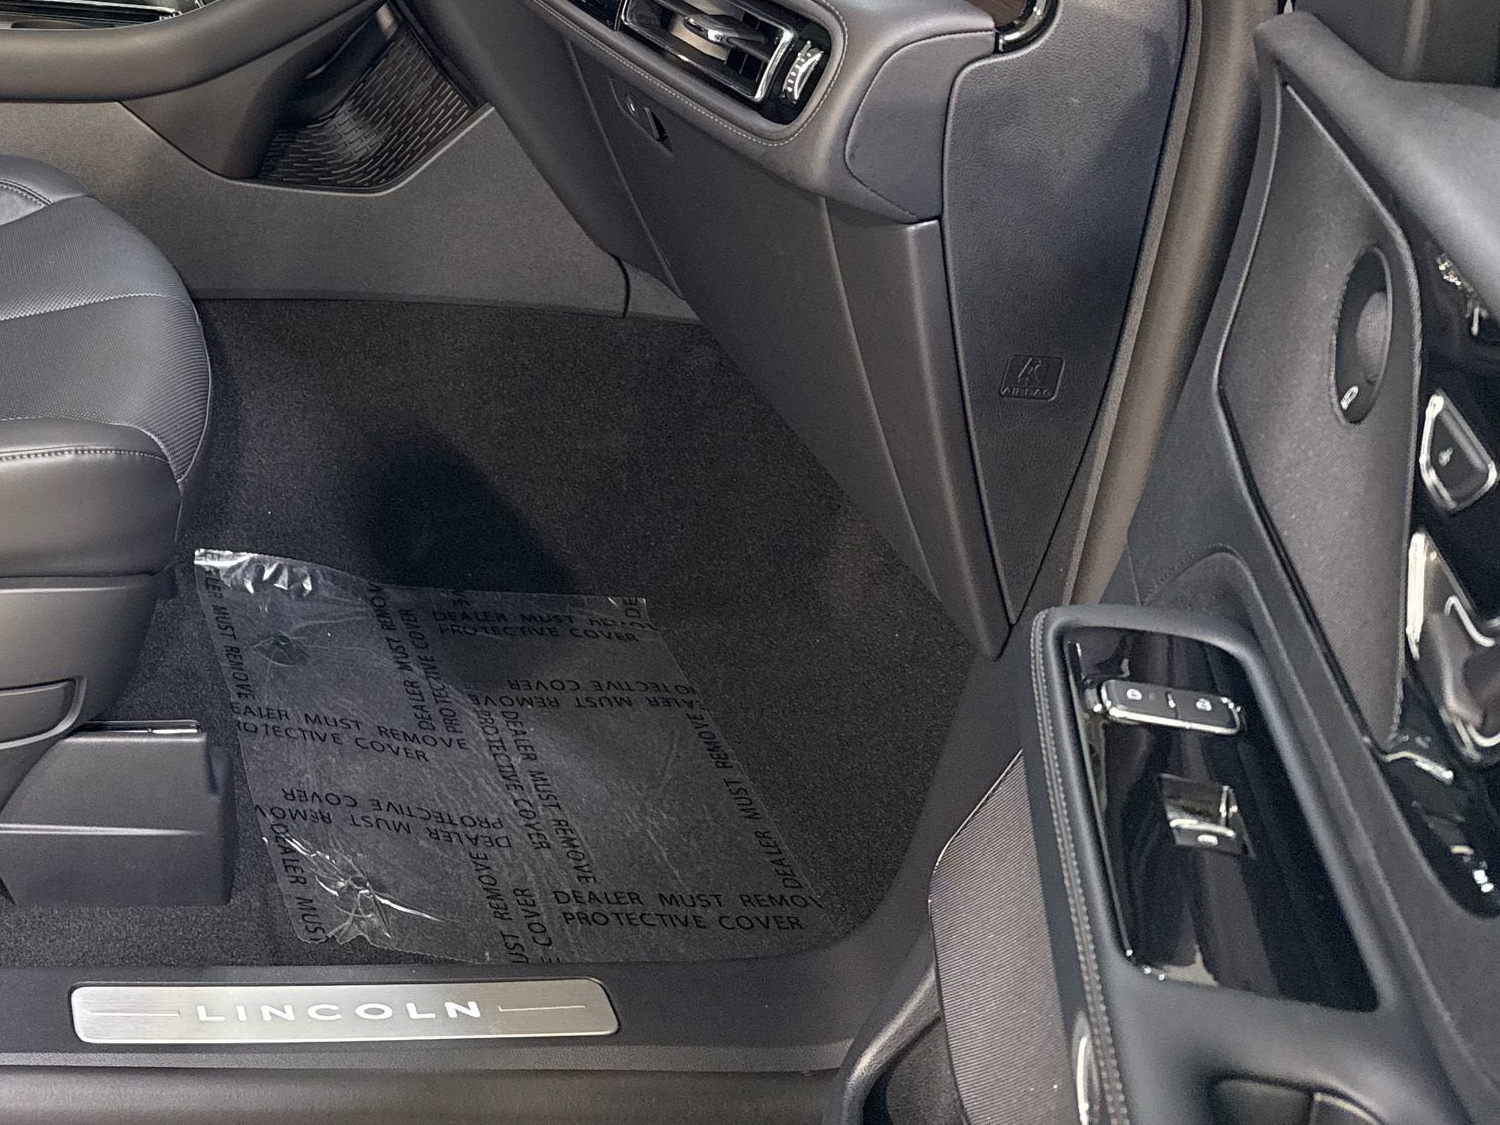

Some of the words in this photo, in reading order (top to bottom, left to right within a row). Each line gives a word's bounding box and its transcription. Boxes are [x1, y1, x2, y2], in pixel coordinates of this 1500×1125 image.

[212, 604, 236, 640] MUST
[399, 608, 429, 650] COVER
[432, 610, 508, 622] DEALER
[520, 613, 575, 625] MUST
[439, 625, 560, 637] PROTECTIVE
[569, 627, 640, 642] COVER
[386, 637, 414, 672] MUST
[223, 645, 255, 700] REMOVE
[507, 679, 580, 691] COVER
[403, 679, 436, 731] DEALER
[417, 654, 463, 734] PROTECTIVE
[468, 694, 560, 708] REMOVE
[574, 696, 633, 708] MUST
[304, 713, 363, 731] MUST
[377, 725, 470, 750] REMOVE
[686, 713, 734, 769] REMOVE
[355, 737, 429, 762] COVER
[475, 709, 524, 791] PROTECTIVE
[513, 798, 551, 850] COVER
[501, 710, 537, 761] DEALER
[528, 770, 562, 811] MUST
[550, 818, 597, 884] REMOVE
[281, 788, 358, 808] COVER
[371, 798, 504, 829] PROTECTIVE
[723, 778, 762, 820] MUST
[350, 814, 411, 835] MUST
[427, 827, 511, 849] DEALER
[270, 823, 307, 886] DEALER
[754, 830, 803, 889] DEALER
[469, 851, 513, 921] REMOVE
[553, 890, 644, 906] DEALER
[658, 892, 723, 908] MUST
[513, 888, 552, 946] COVER
[562, 911, 706, 928] PROTECTIVE
[719, 914, 804, 931] COVER
[195, 1000, 481, 1022] LINCOLN
